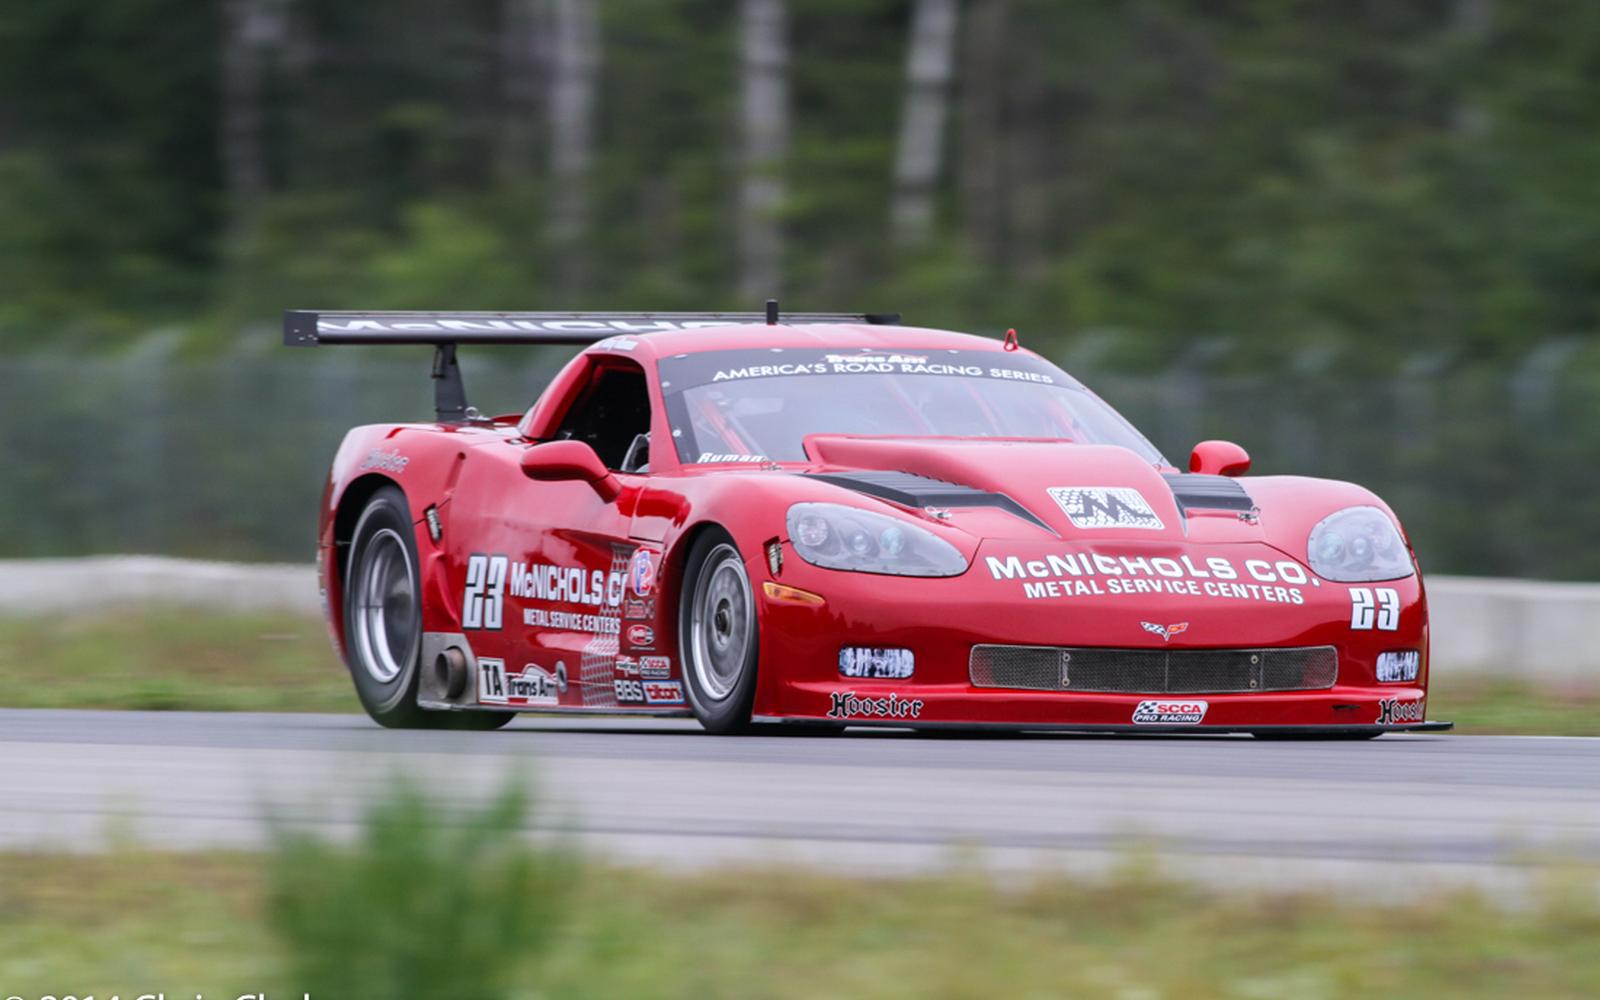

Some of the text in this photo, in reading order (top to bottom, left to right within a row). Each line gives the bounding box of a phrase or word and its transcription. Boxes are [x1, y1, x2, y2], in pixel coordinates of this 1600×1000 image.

[712, 362, 1054, 384] AMERICA'S ROAD RACING SERIES
[696, 452, 764, 464] Ruman
[510, 561, 604, 606] McNICHOLS
[985, 553, 1321, 587] McNICHOLS CO.
[461, 553, 509, 631] 23
[1022, 577, 1305, 606] METAL SERVICE CENTERS
[523, 608, 550, 627] METAL
[550, 611, 583, 631] SERVICE
[583, 614, 621, 635] CENTERS
[1349, 587, 1400, 632] 23
[482, 664, 504, 697] TA
[506, 674, 537, 697] Trans
[614, 680, 644, 701] BBS
[826, 691, 924, 718] Hoosier
[1135, 714, 1201, 722] PRO RACING
[1157, 704, 1201, 713] SCCA
[1375, 697, 1425, 725] Hoos
